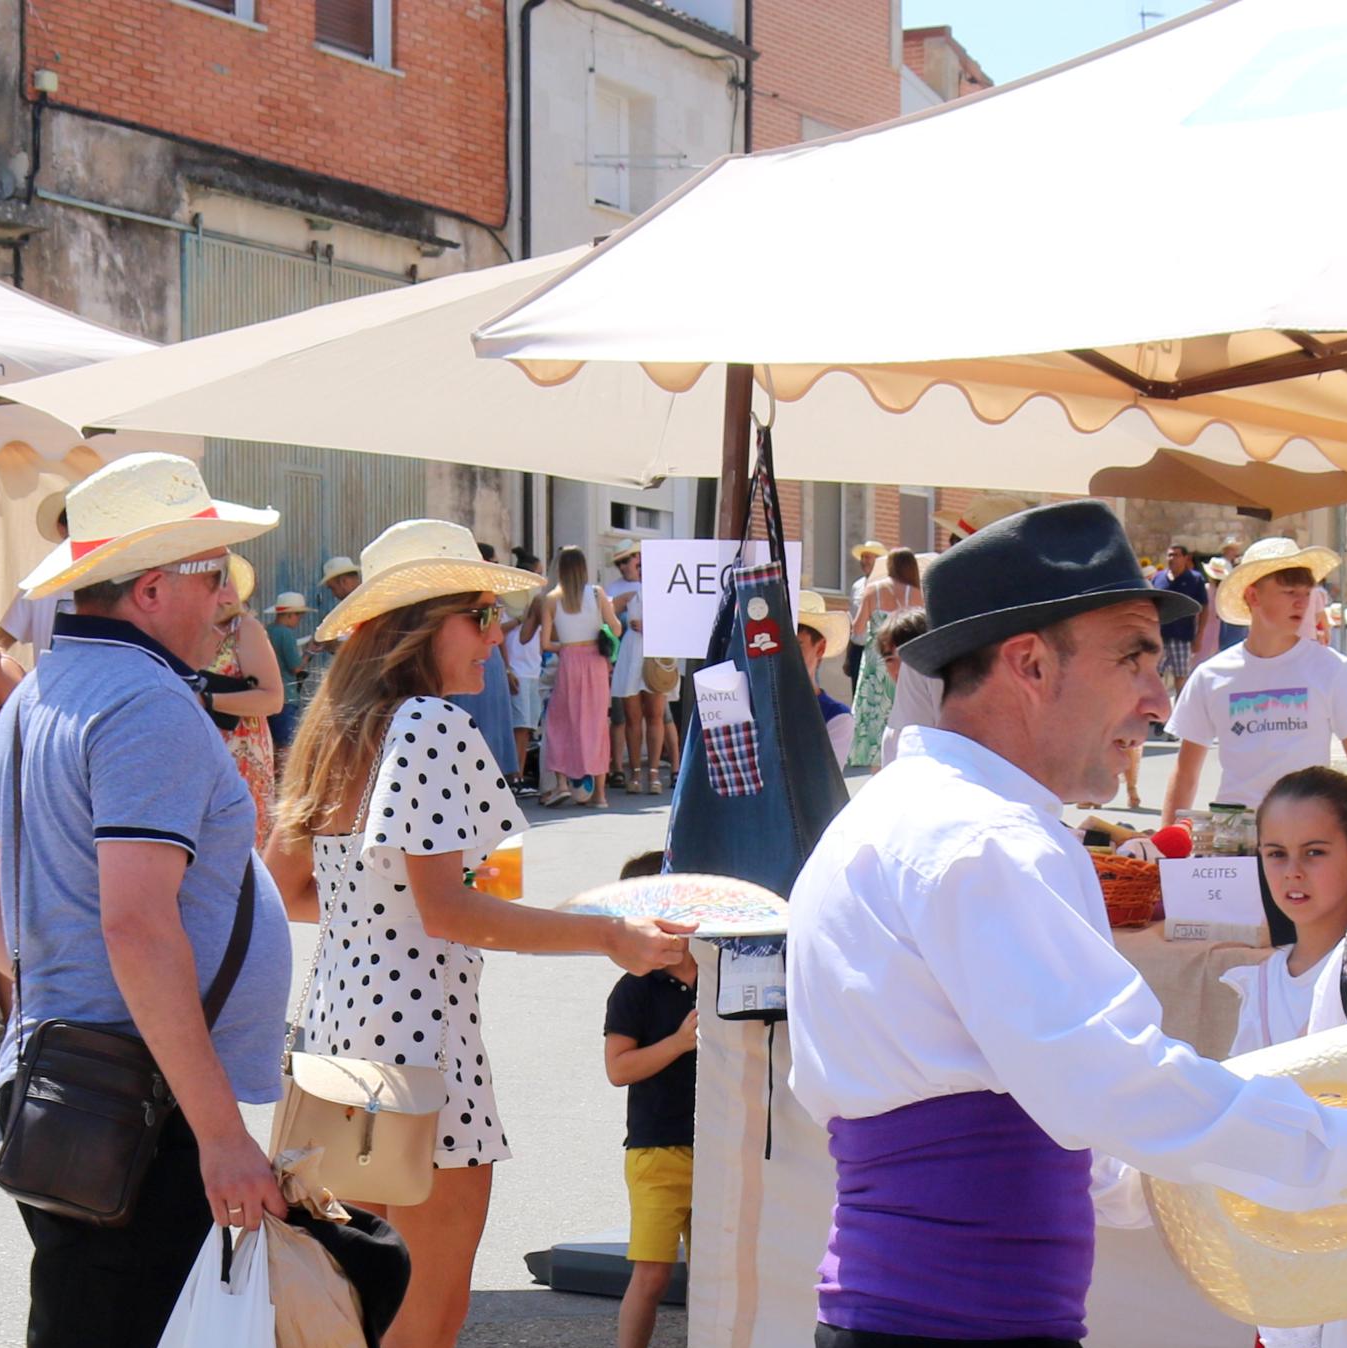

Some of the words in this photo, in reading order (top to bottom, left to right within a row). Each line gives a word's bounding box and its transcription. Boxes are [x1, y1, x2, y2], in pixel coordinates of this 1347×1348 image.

[179, 560, 218, 575] NIKE
[699, 691, 739, 703] ANTAL
[702, 710, 723, 723] 10€
[1246, 717, 1308, 734] Columbia
[1192, 868, 1238, 879] ACEITES
[1207, 889, 1222, 900] 5€
